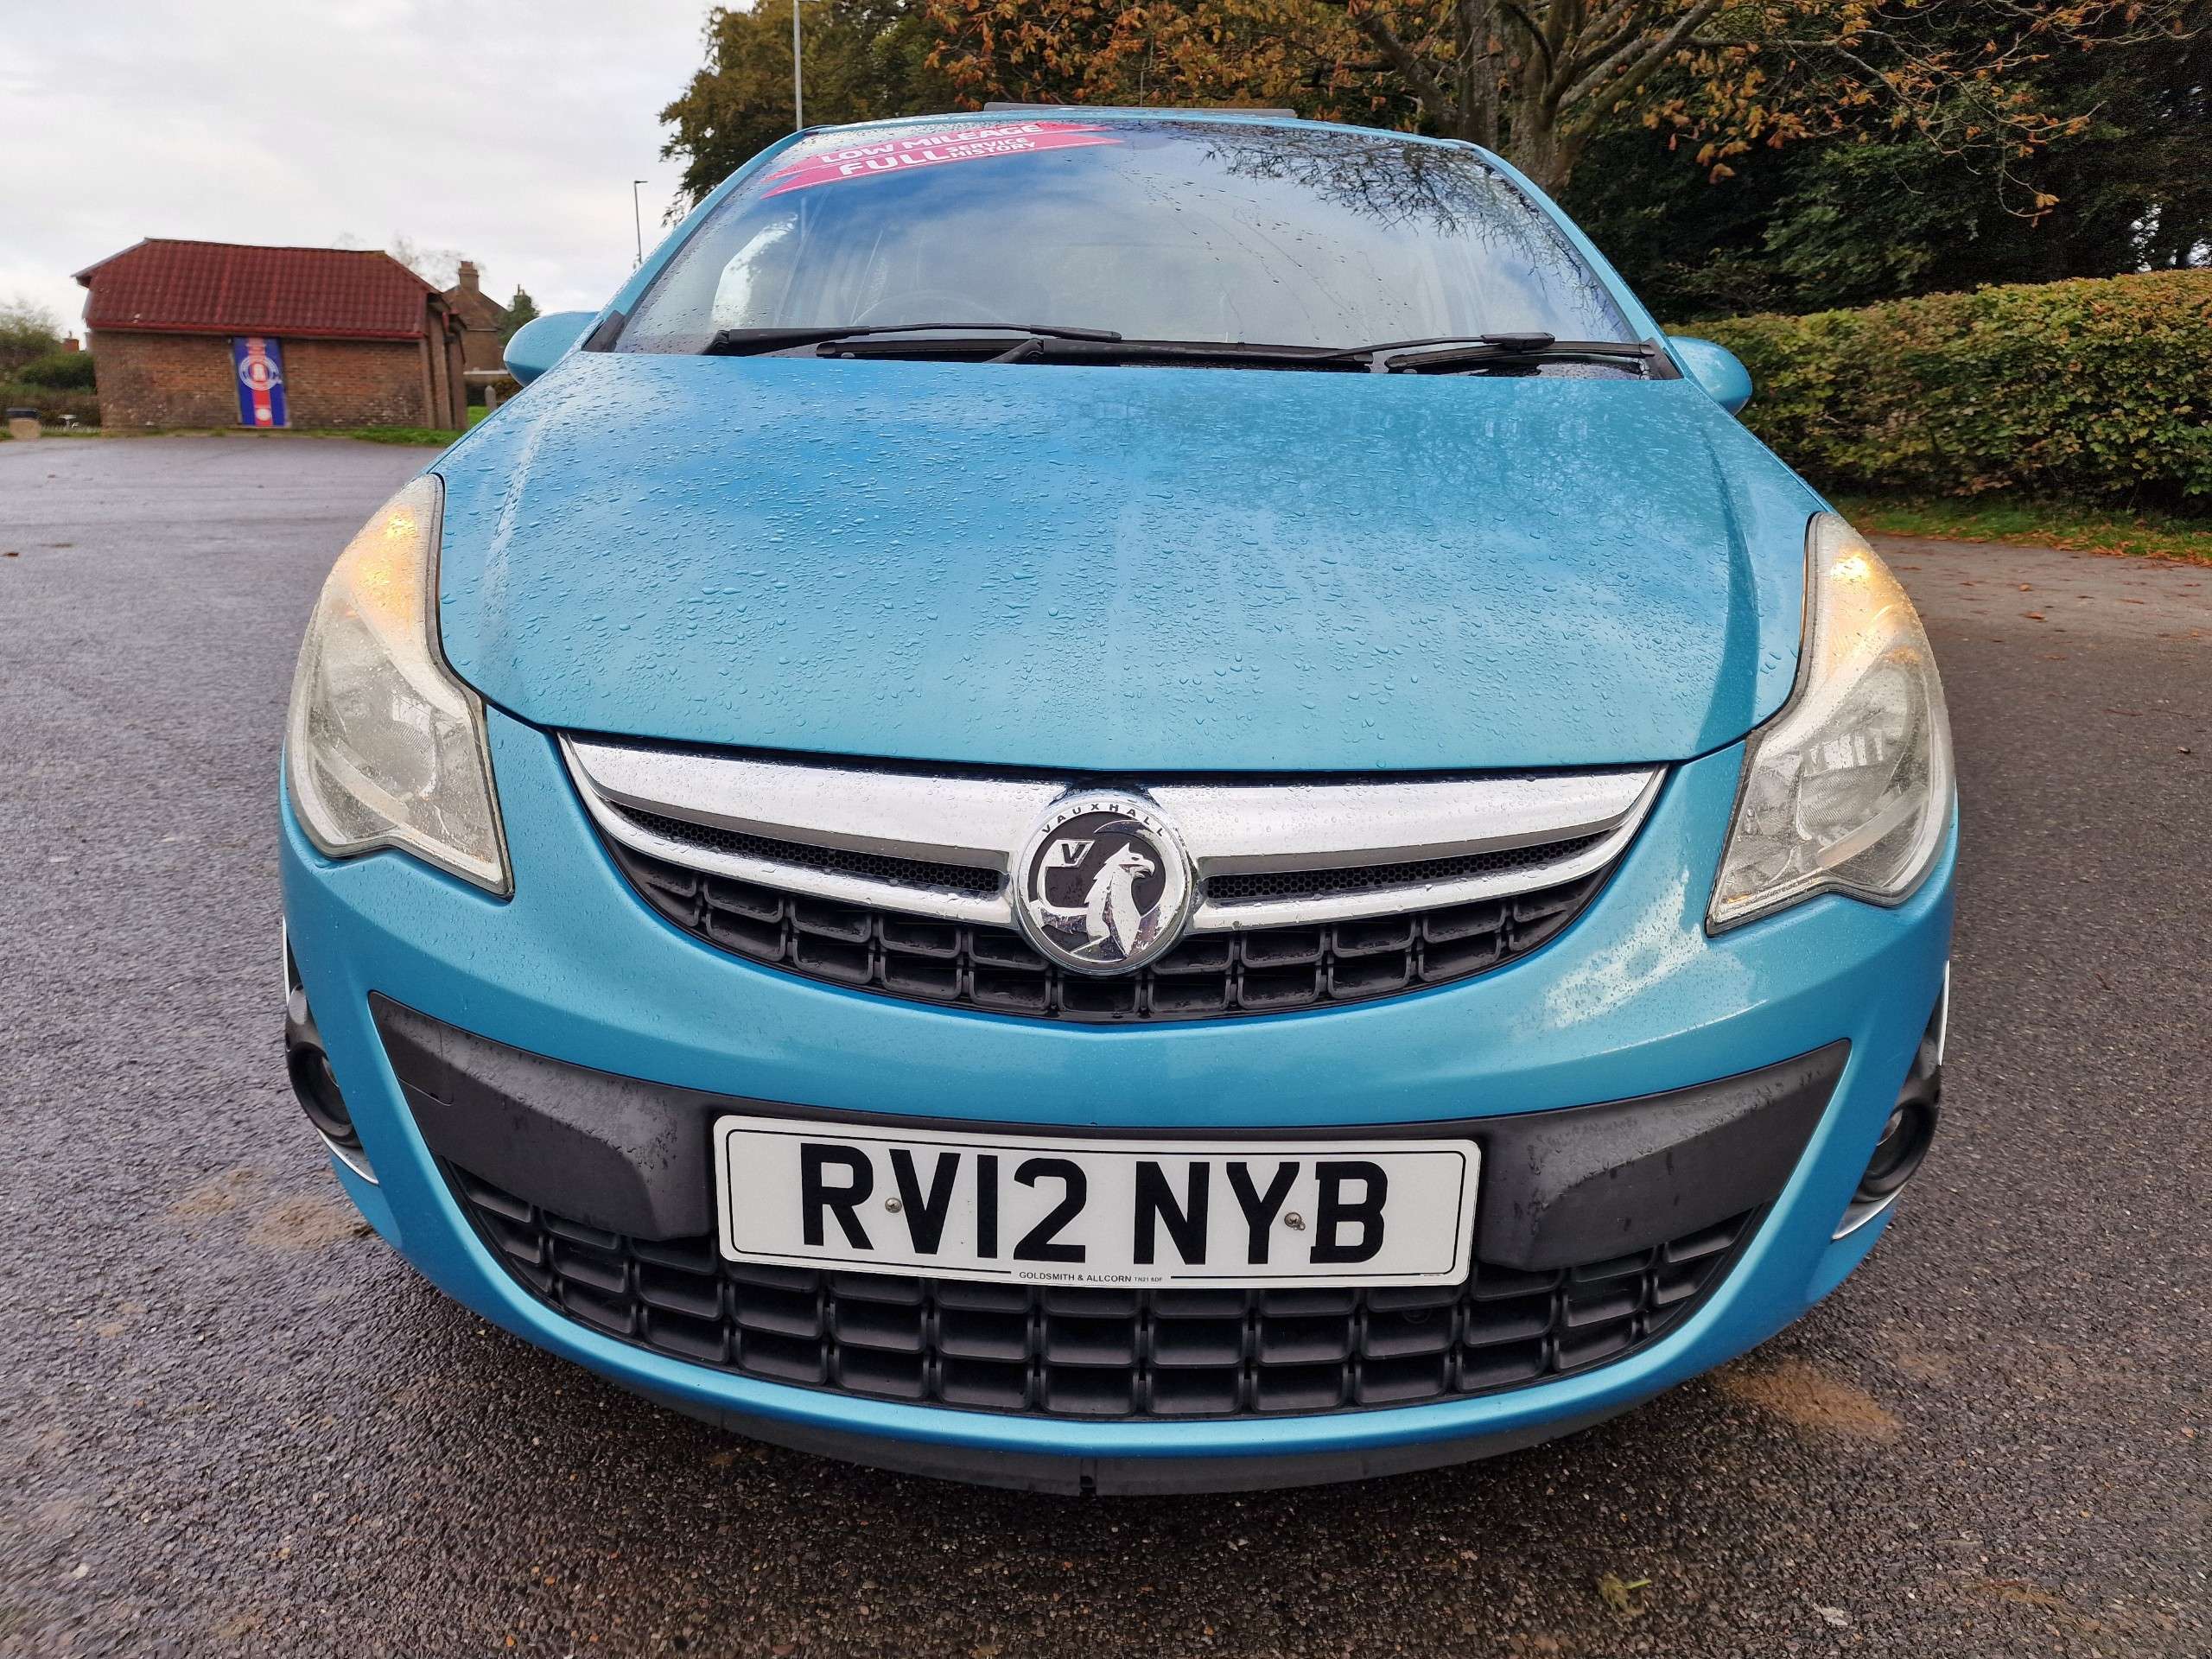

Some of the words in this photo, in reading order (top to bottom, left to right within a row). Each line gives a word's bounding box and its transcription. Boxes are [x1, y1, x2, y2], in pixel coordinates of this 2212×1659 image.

[821, 143, 893, 163] LOW
[902, 124, 1044, 149] MILEAGE
[945, 137, 1027, 153] SERVICE
[949, 142, 1035, 157] HISTORY
[838, 150, 950, 175] FULL
[1041, 803, 1165, 837] VAUXHALL
[800, 1141, 1089, 1264] RV12
[1133, 1160, 1389, 1266] NYB
[1019, 1271, 1075, 1281] GOLDSMITH
